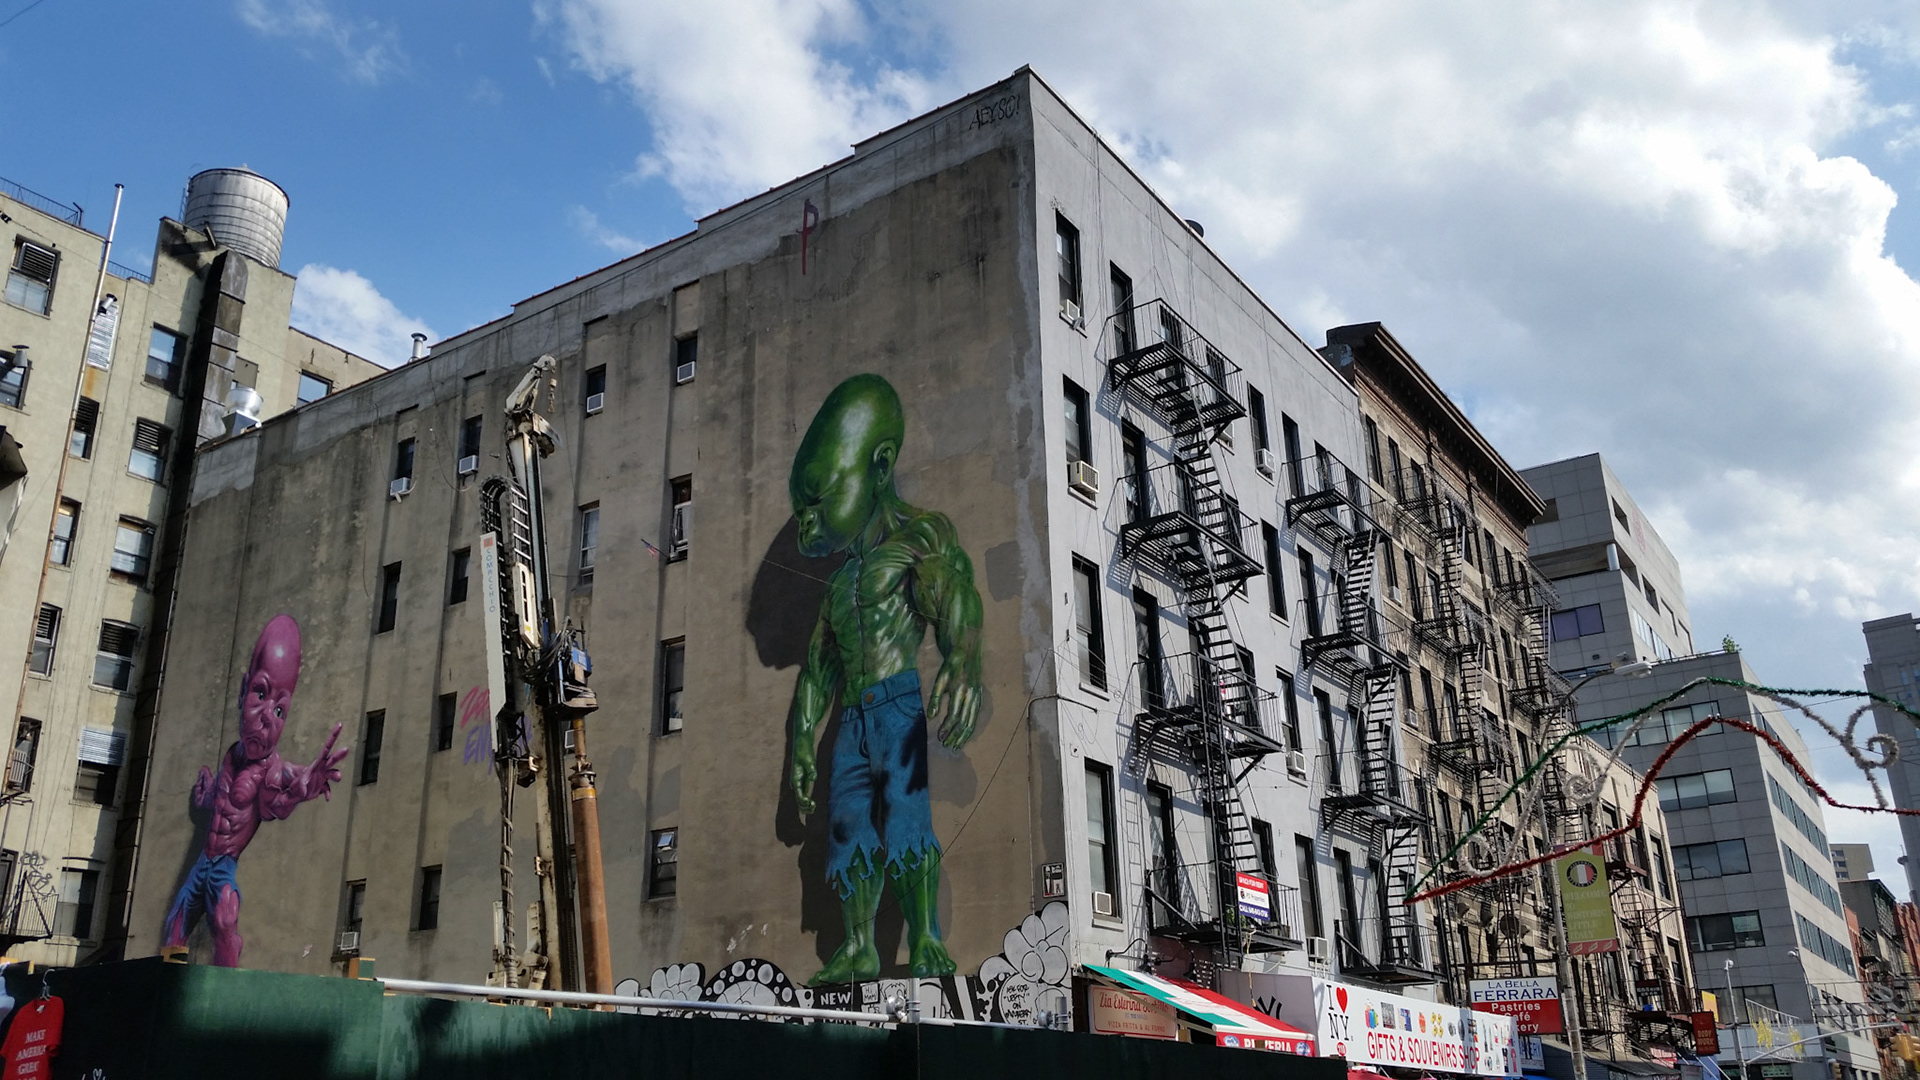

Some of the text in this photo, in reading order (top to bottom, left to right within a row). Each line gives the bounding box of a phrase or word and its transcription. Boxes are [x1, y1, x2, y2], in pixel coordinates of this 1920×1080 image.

[486, 548, 496, 613] COMACCHIO
[1505, 980, 1539, 988] BELLA
[820, 992, 851, 1006] NEW
[1100, 992, 1112, 1008] Zia
[1474, 988, 1556, 1001] FERRARA
[1491, 1002, 1541, 1012] Pastries
[25, 1029, 46, 1043] MAKE
[1367, 1031, 1396, 1061] GIFTS
[1398, 1036, 1406, 1062] &
[1407, 1037, 1458, 1068] SOUVENIRS
[1458, 1045, 1480, 1069] SHOP
